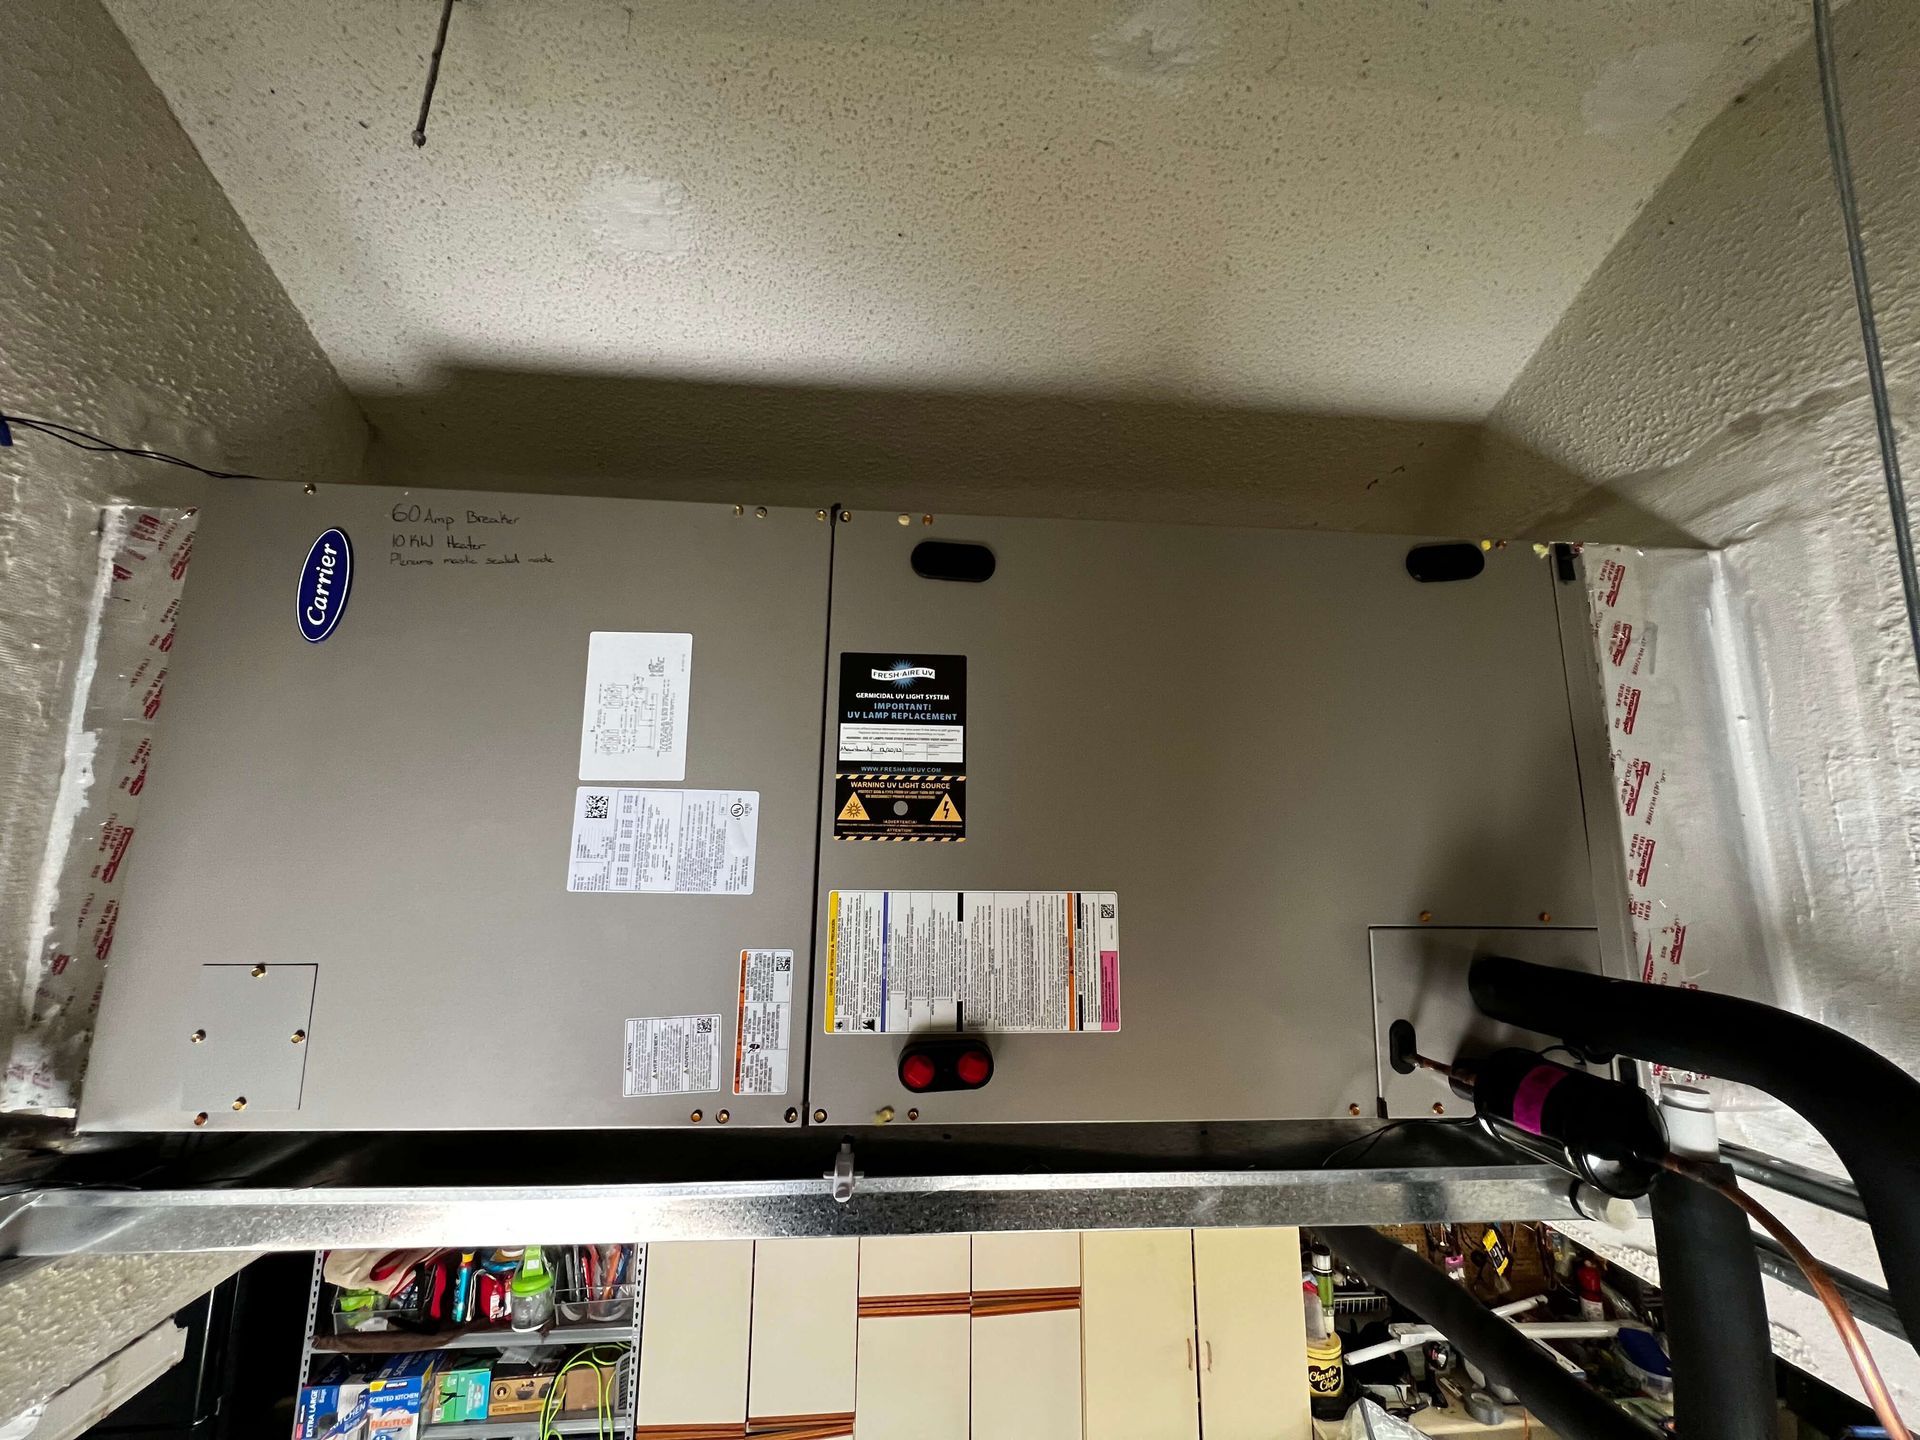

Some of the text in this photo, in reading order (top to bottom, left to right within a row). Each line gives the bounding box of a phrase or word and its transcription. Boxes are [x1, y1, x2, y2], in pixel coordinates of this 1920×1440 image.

[392, 503, 520, 530] 60 Amp Breaker
[392, 534, 406, 547] 10
[446, 535, 486, 550] Heater
[443, 555, 478, 565] mastic
[485, 554, 520, 564] sealed
[307, 543, 337, 626] Carrier
[874, 702, 931, 710] IMPORTANT!
[1640, 840, 1656, 868] Venture
[1310, 1368, 1336, 1382] Charles
[369, 1392, 419, 1404] SCENTED KITCHEN
[306, 1390, 318, 1438] EXTRA LARGE
